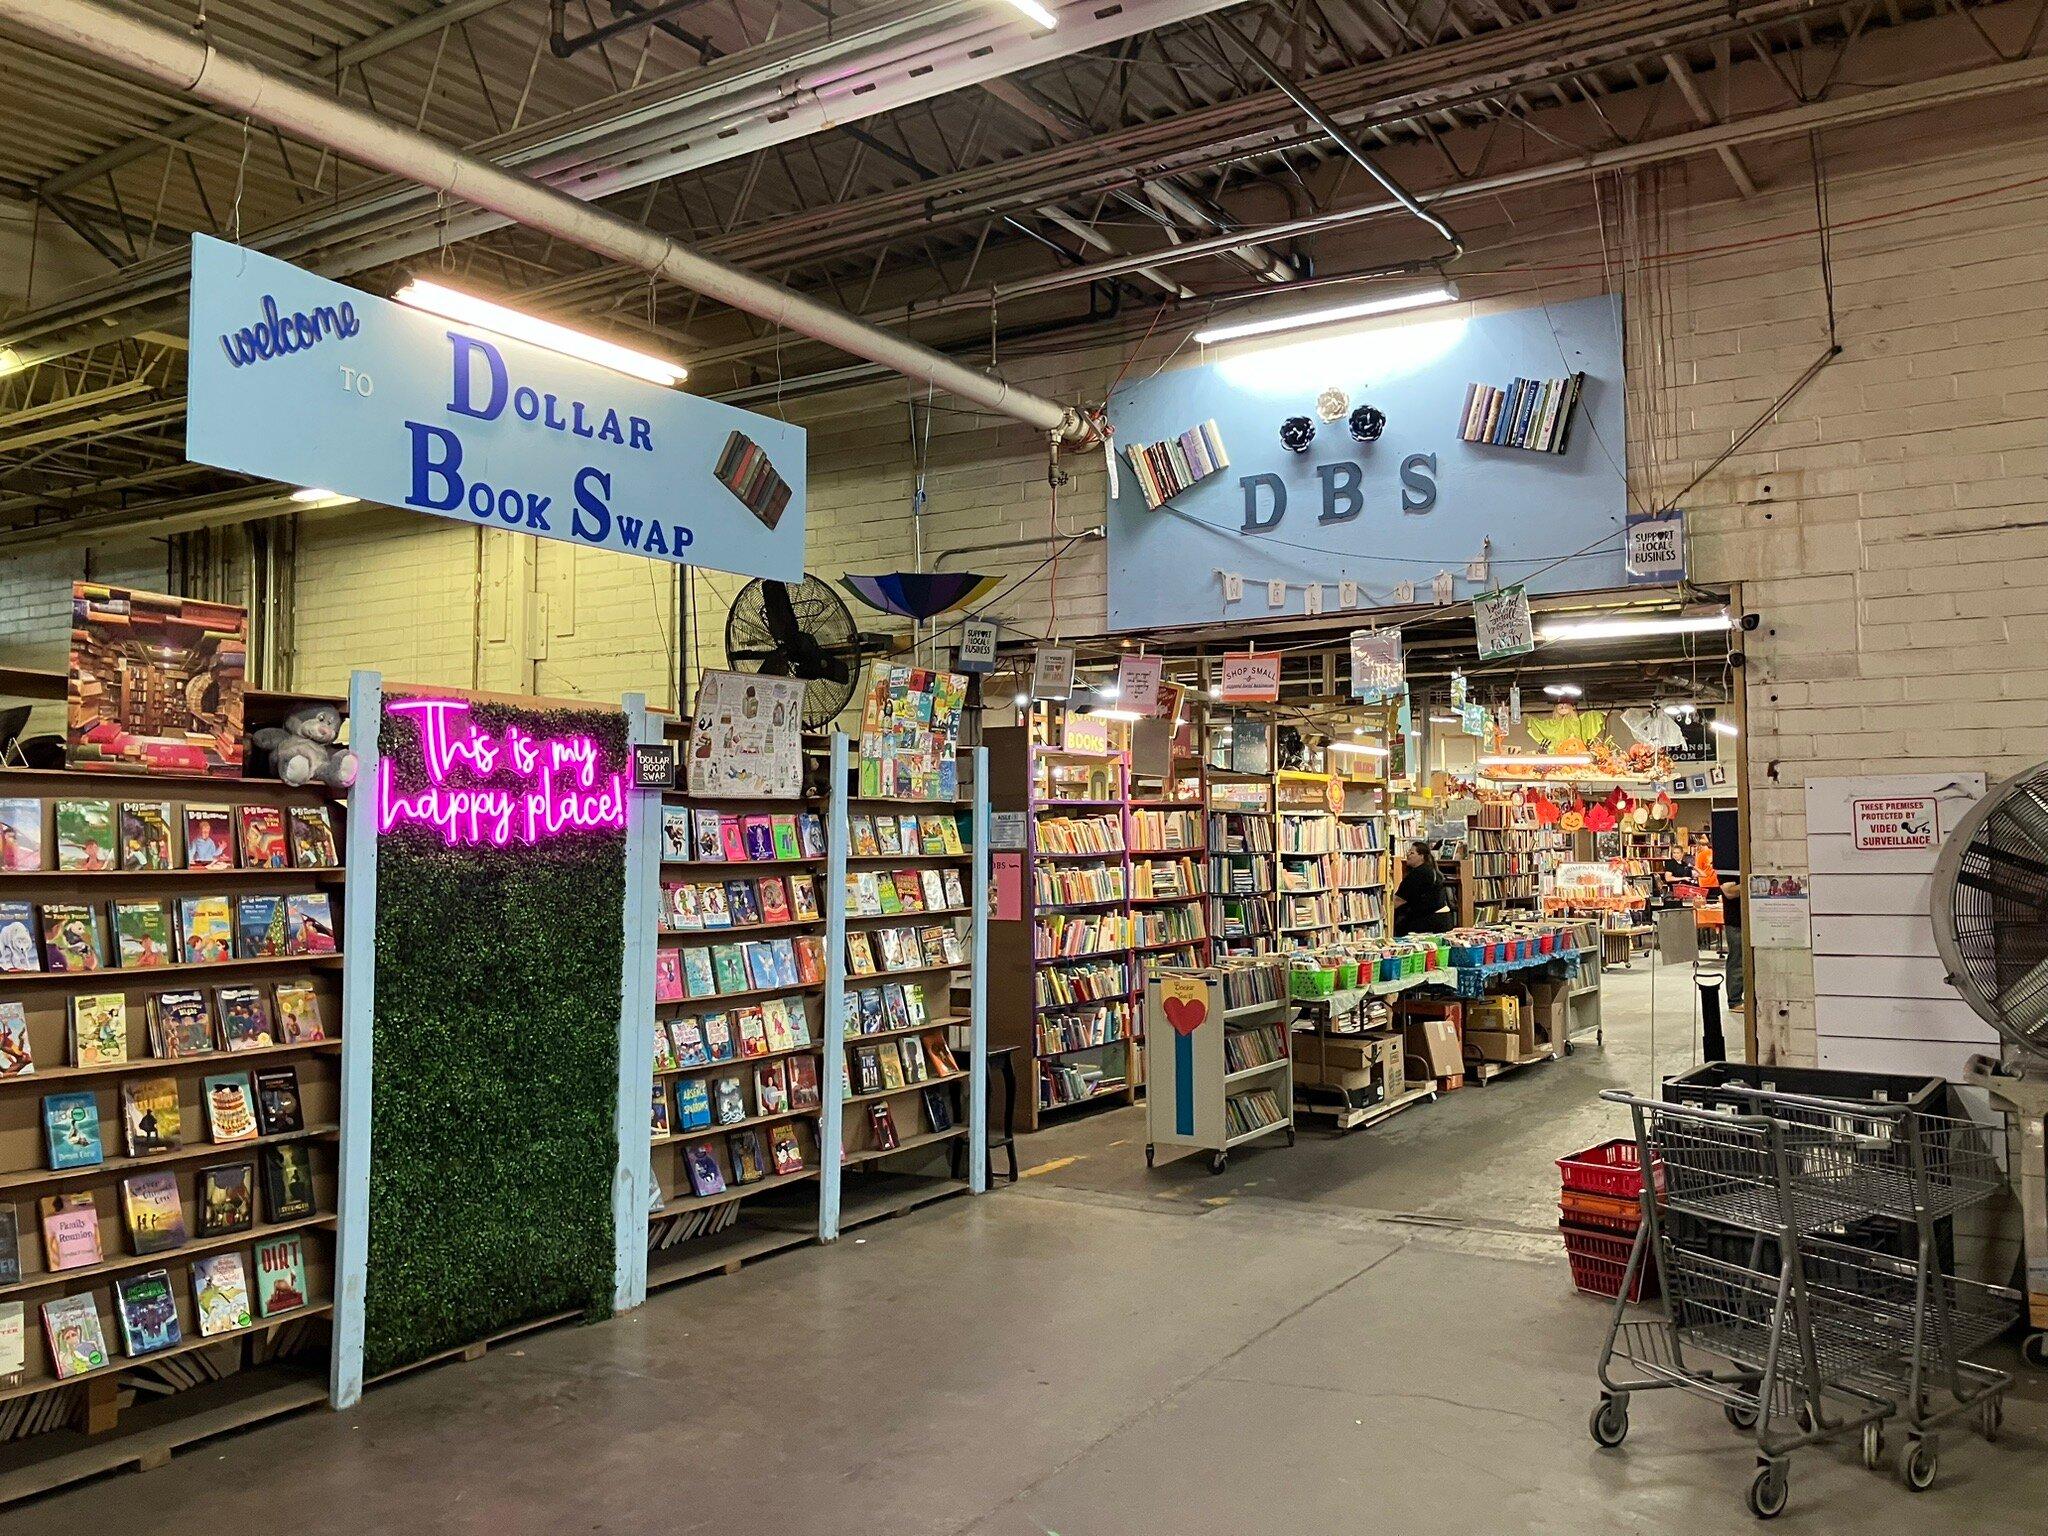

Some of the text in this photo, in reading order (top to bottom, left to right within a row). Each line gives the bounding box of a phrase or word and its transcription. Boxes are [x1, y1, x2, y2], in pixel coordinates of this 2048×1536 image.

[220, 294, 361, 368] welcome
[337, 364, 375, 398] TO
[445, 330, 655, 452] DOLLAR
[404, 419, 695, 559] BOOK SWAP
[1642, 541, 1667, 551] LOCAL
[1635, 550, 1676, 563] BUSINESS
[1226, 666, 1276, 681] SHOP SMALL
[385, 700, 598, 787] This is my
[1066, 731, 1106, 754] BOOKS
[639, 755, 670, 765] DOLLAR
[1671, 753, 1697, 761] OOM
[643, 763, 666, 772] BOOK
[642, 772, 666, 781] SWAP
[381, 756, 626, 845] happy place!
[1861, 801, 1924, 811] THESE PREMISES
[1861, 811, 1916, 820] PROTECTED BY
[1870, 824, 1898, 833] VIDEO
[1862, 836, 1931, 846] SURVEILLANCE
[861, 1055, 875, 1067] THE
[59, 1219, 85, 1231] Family
[59, 1230, 93, 1243] Reunion
[261, 1241, 299, 1273] DIRT
[0, 1258, 17, 1274] ER
